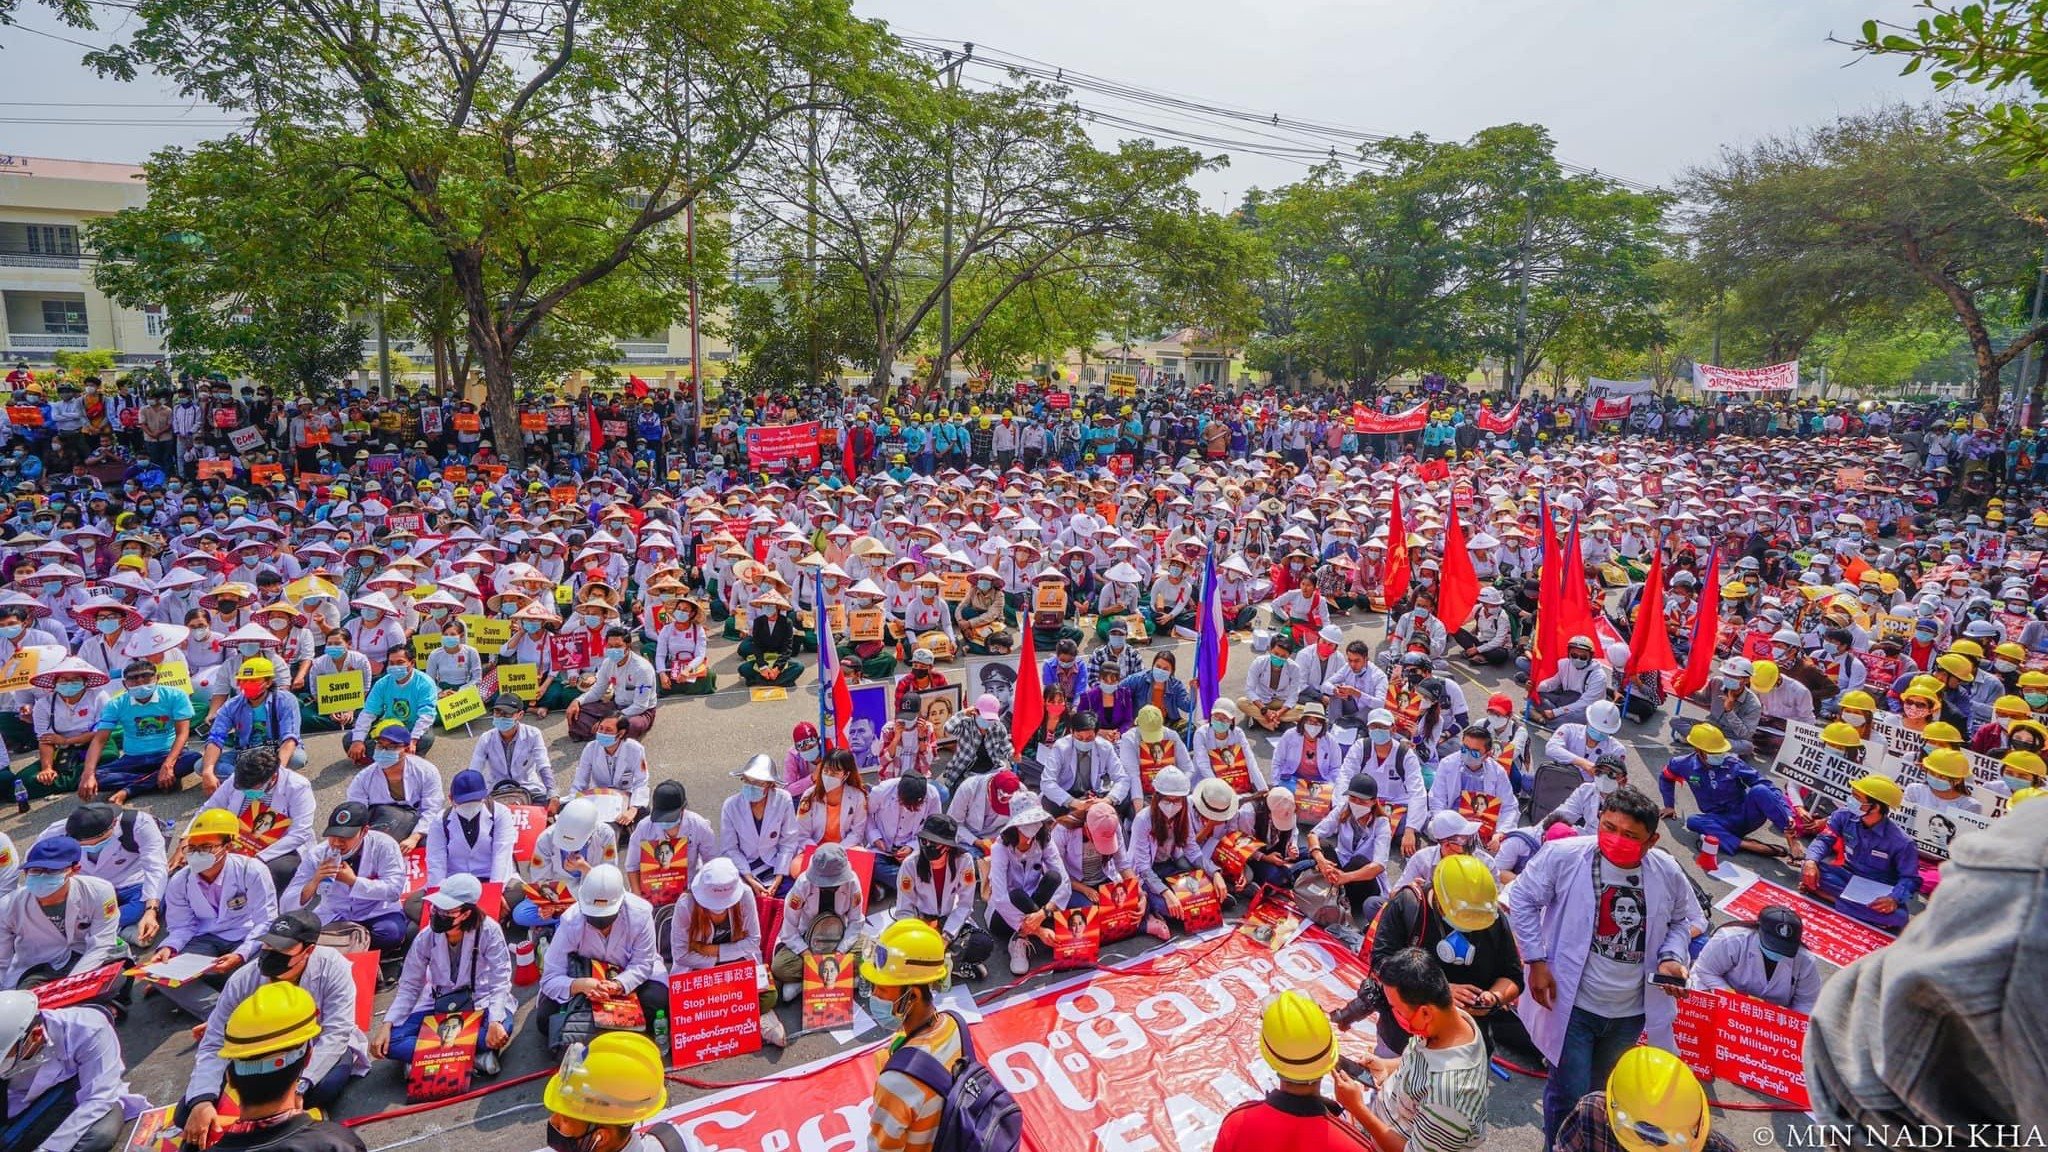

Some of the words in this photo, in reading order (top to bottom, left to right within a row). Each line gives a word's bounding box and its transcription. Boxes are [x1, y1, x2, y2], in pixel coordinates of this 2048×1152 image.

[484, 627, 500, 636] Save
[1882, 620, 1911, 631] CDM
[424, 641, 442, 650] Save
[329, 681, 350, 692] Save
[508, 674, 526, 682] Save
[321, 690, 362, 704] Myanmar
[502, 682, 536, 694] Myanmar
[444, 702, 481, 721] Myanmar
[450, 698, 469, 710] Save
[1895, 728, 1927, 747] NEW
[1800, 744, 1827, 764] THE
[1827, 755, 1870, 781] NEWS
[1974, 754, 2000, 771] THE
[1782, 766, 1815, 786] MWD
[1793, 756, 1824, 776] ARE
[1823, 768, 1852, 788] LYIN
[672, 966, 754, 994] 停止帮助军事政变
[683, 998, 705, 1010] Stop
[708, 990, 743, 1004] Helping
[674, 1016, 692, 1026] The
[694, 1008, 728, 1022] Military
[730, 1002, 756, 1014] Coup
[1684, 1008, 1710, 1022] affairs.
[1728, 1018, 1752, 1034] Stop
[1755, 1026, 1797, 1048] Helping
[1716, 1028, 1736, 1042] The
[1739, 1036, 1780, 1057] Military
[1782, 1048, 1804, 1063] Cou
